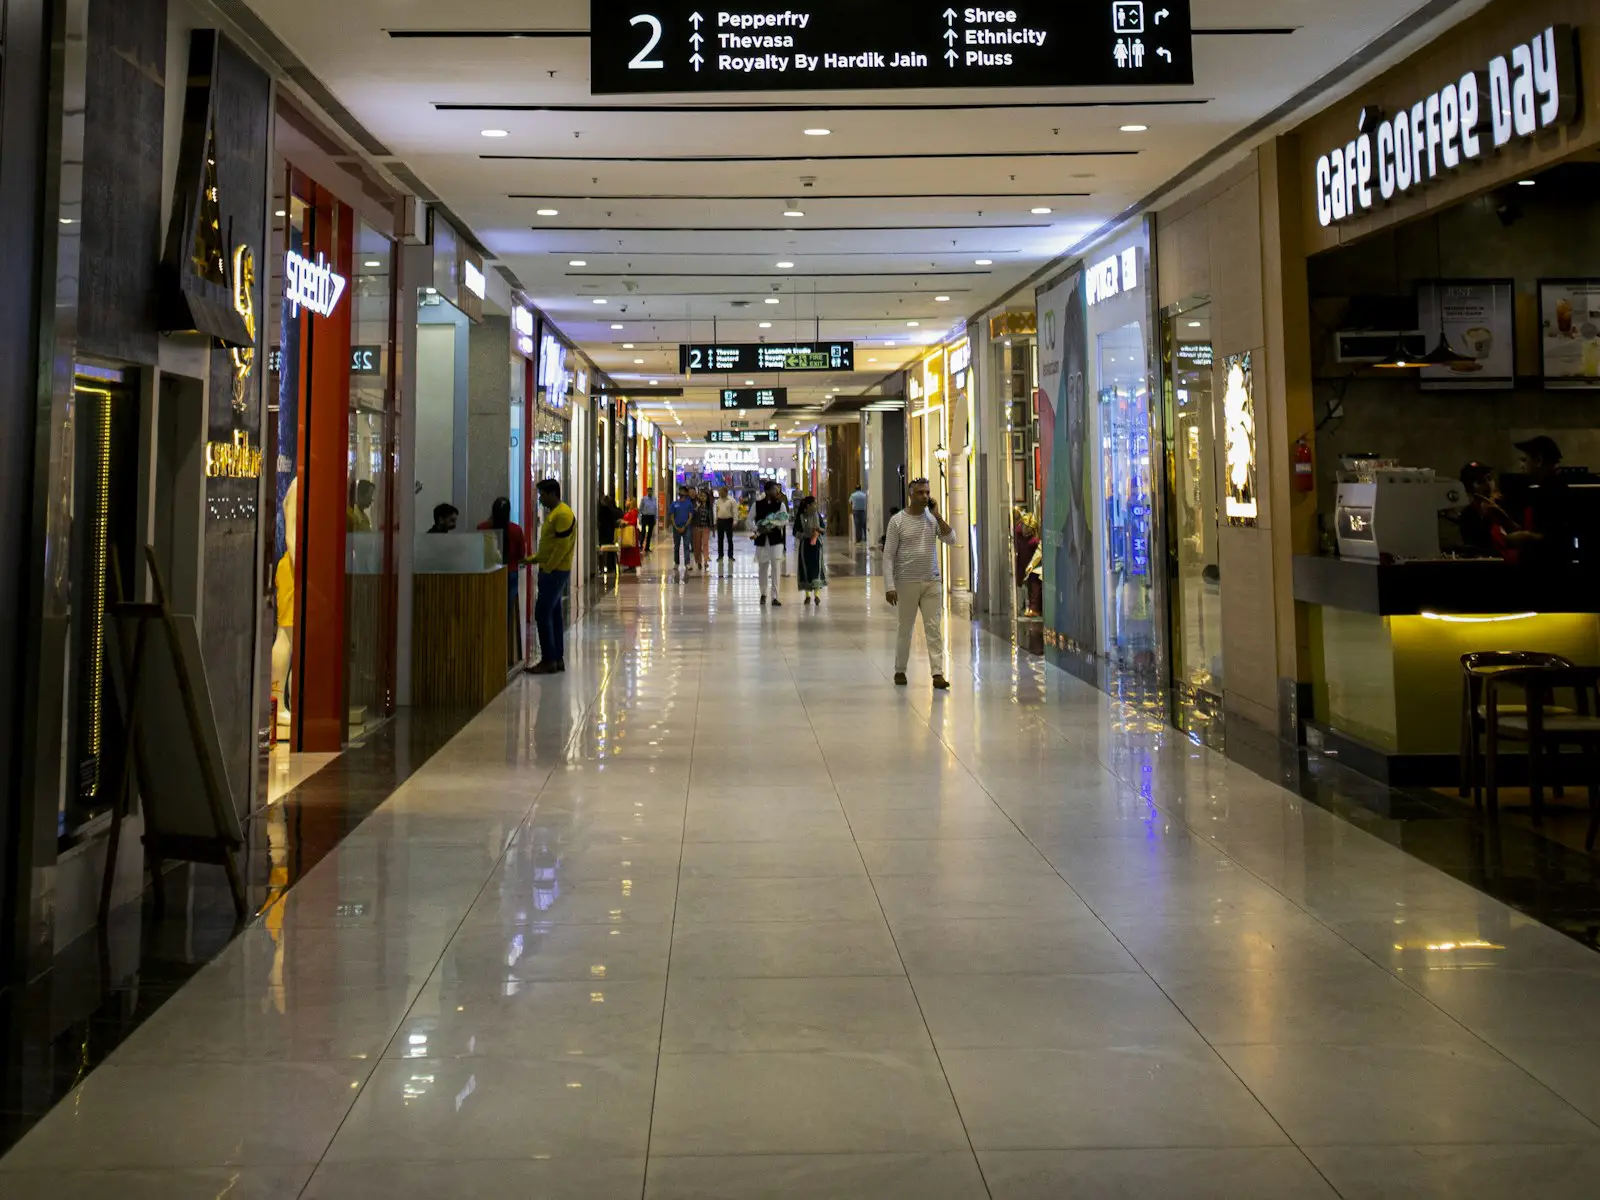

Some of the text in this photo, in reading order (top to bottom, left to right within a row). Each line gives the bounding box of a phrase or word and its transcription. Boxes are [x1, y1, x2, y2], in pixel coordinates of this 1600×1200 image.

[718, 11, 809, 29] Pepperfry
[965, 8, 1016, 23] Shree
[629, 14, 663, 69] 2
[718, 33, 793, 48] Thevasa
[966, 29, 1046, 46] Ethnicity
[719, 51, 927, 72] Royalty By Hardik Jain
[966, 51, 1012, 65] Pluss
[690, 349, 702, 369] 2
[715, 348, 739, 356] Thevasa
